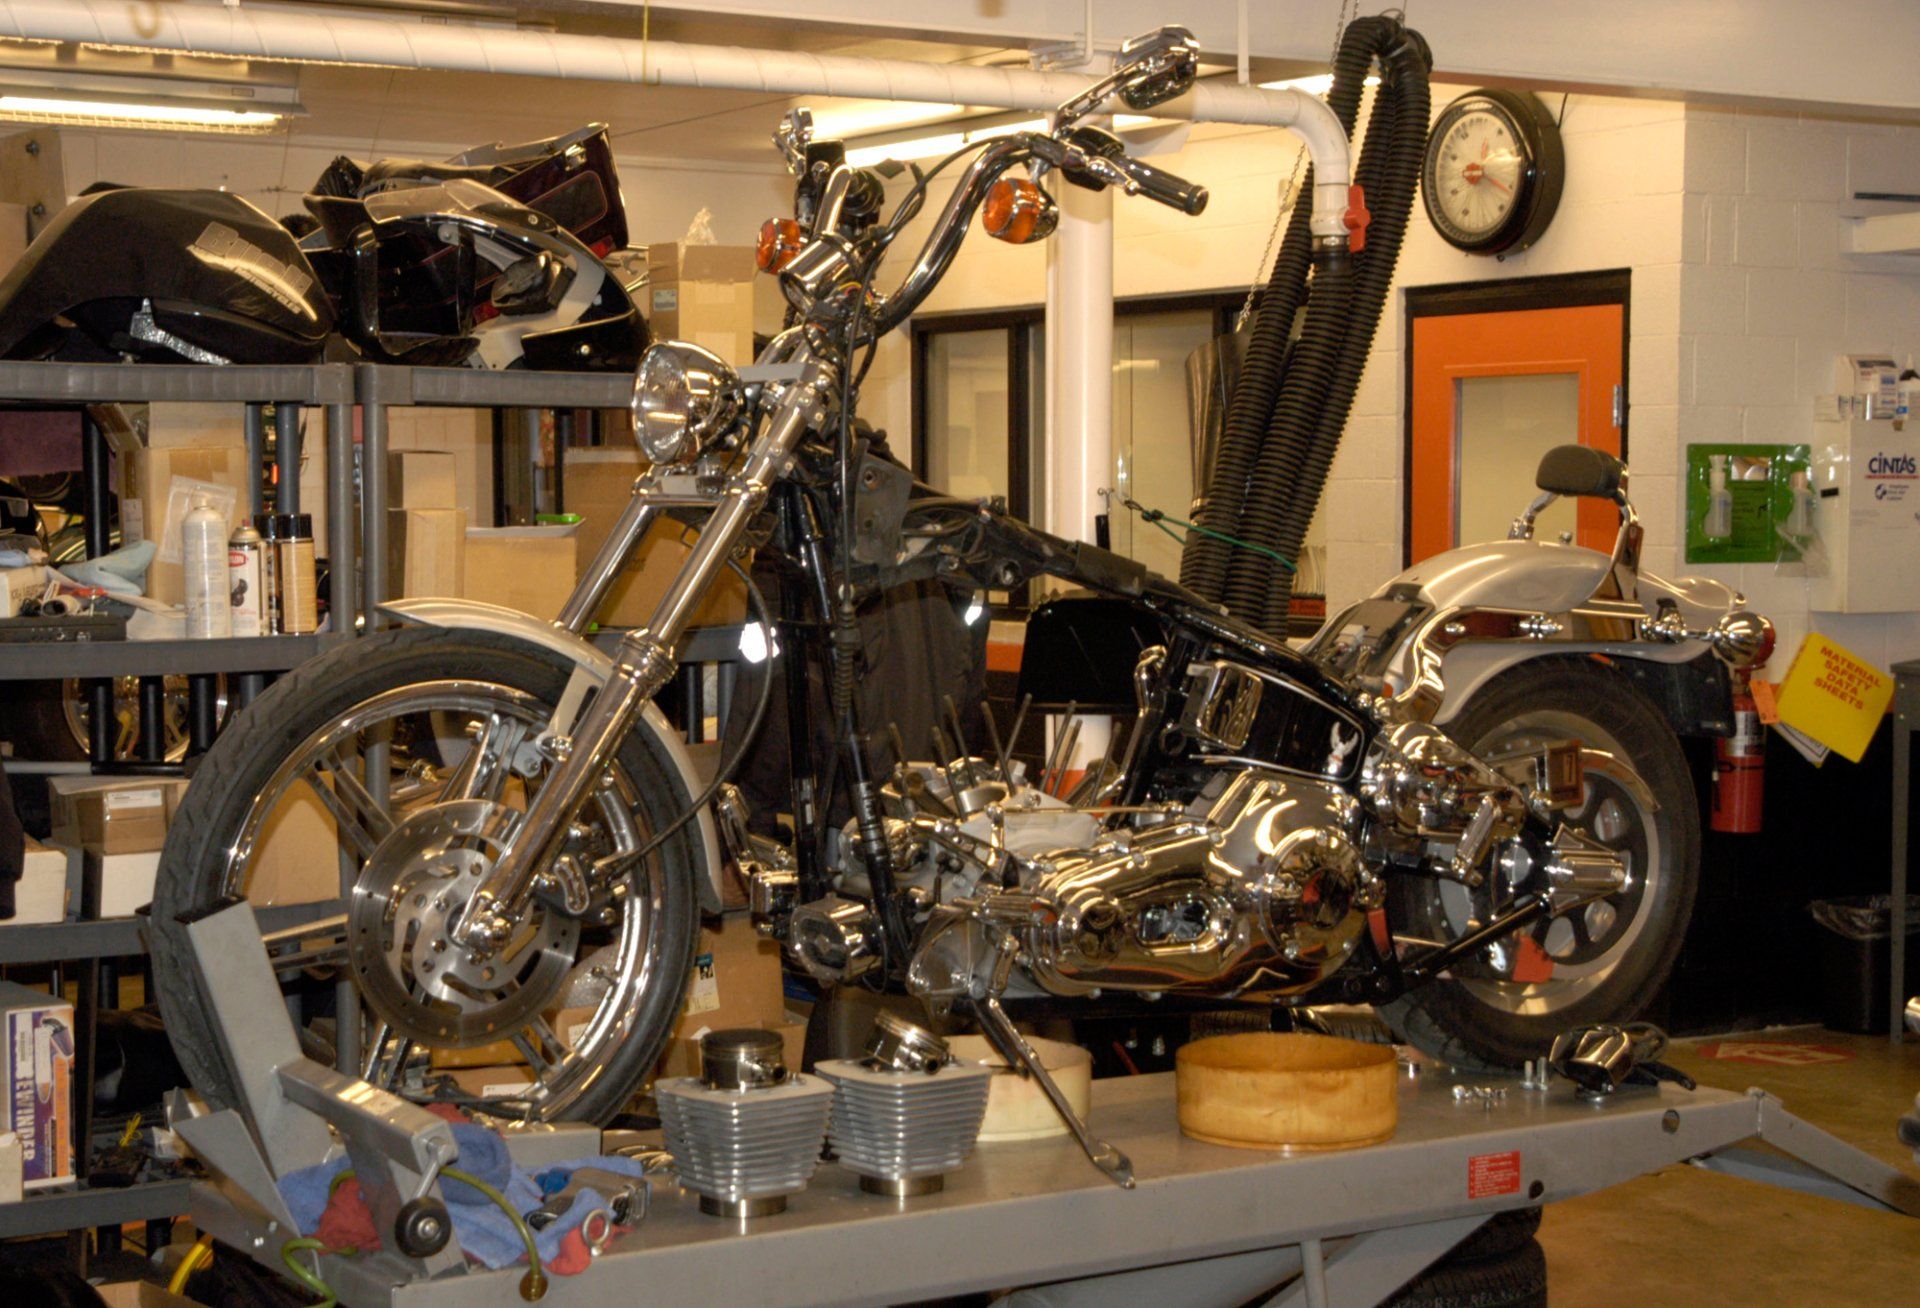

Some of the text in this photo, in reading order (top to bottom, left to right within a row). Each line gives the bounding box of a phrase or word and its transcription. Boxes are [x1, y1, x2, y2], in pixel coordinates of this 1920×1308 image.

[1868, 451, 1916, 474] CINTAS
[1820, 646, 1881, 687] MATERIAL
[1824, 660, 1871, 692] SAFETY
[1814, 677, 1864, 710] SHEETS
[1826, 673, 1859, 695] DATA
[16, 1078, 36, 1161] EWINDER
